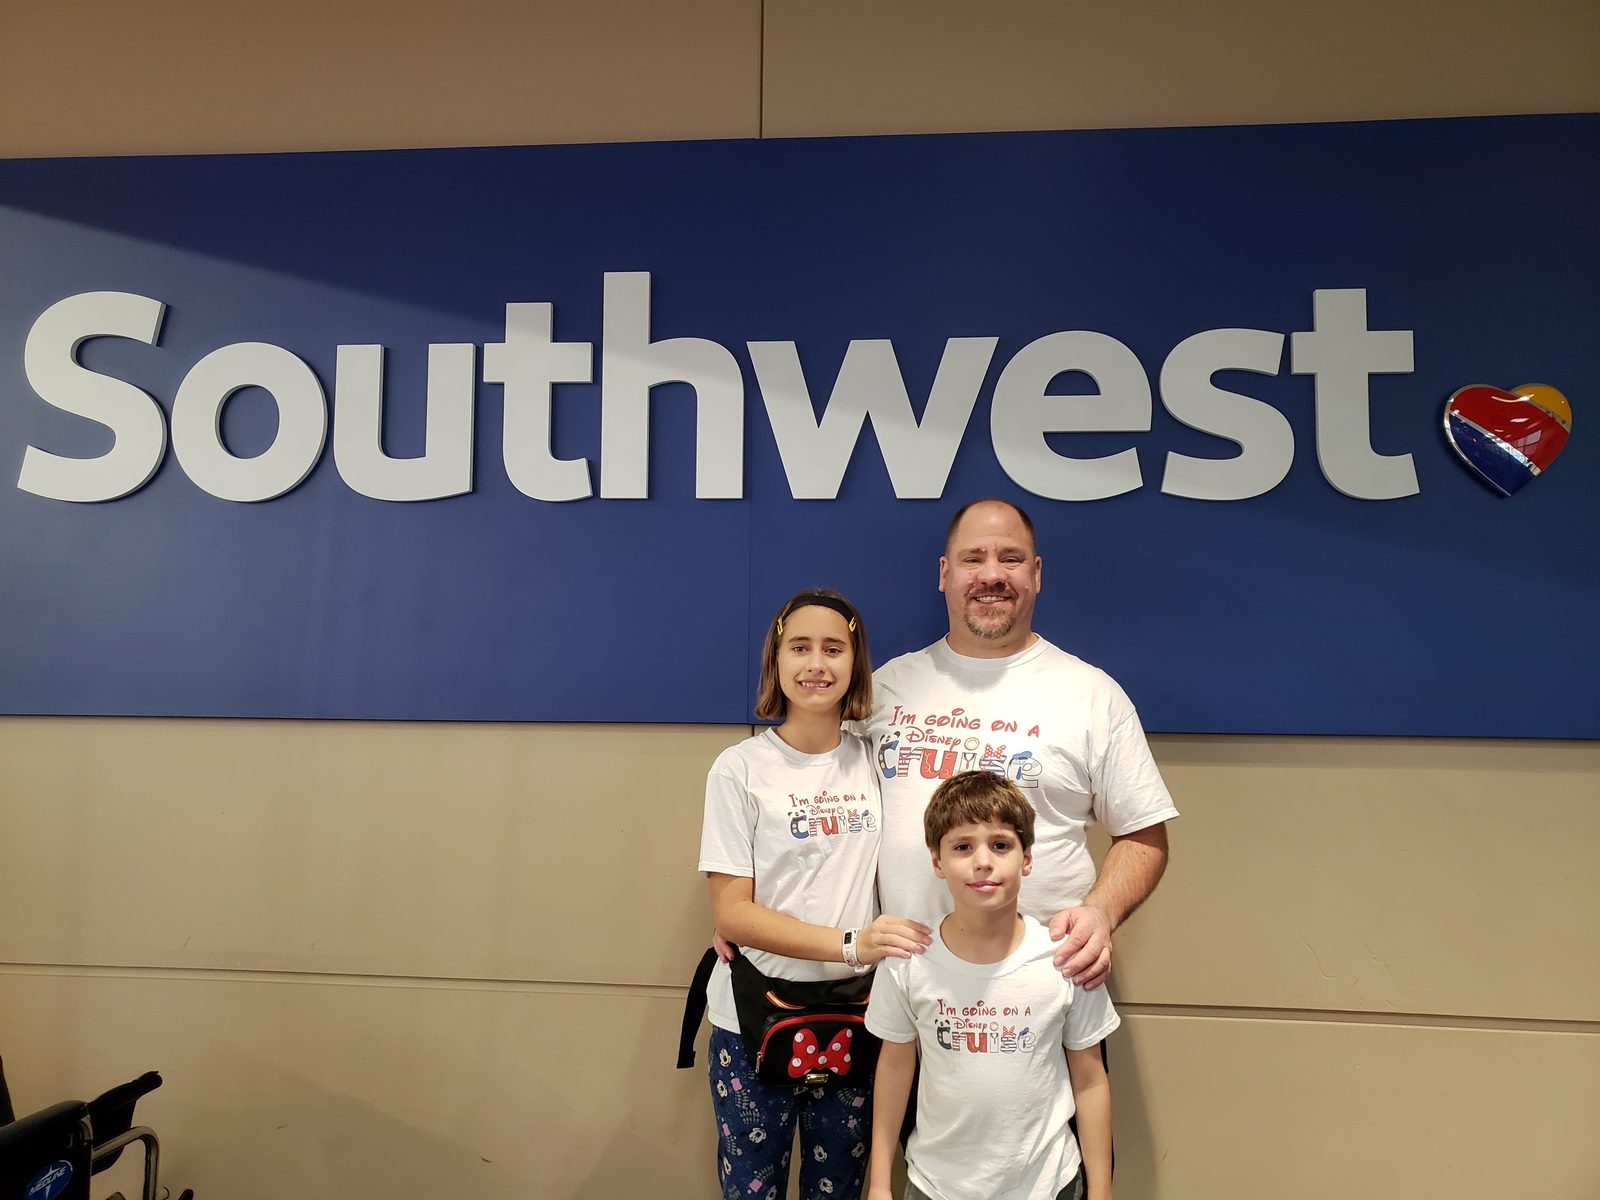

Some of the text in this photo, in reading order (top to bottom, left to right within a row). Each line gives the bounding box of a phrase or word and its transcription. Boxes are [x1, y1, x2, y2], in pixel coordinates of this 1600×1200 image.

[17, 271, 1420, 502] Southwest
[888, 705, 916, 727] I'm
[991, 720, 1018, 732] ON
[1027, 725, 1040, 738] A
[788, 794, 809, 807] I'm
[860, 793, 867, 801] A
[937, 999, 956, 1015] I'm
[1003, 1006, 1019, 1016] ON
[1024, 1006, 1031, 1016] A
